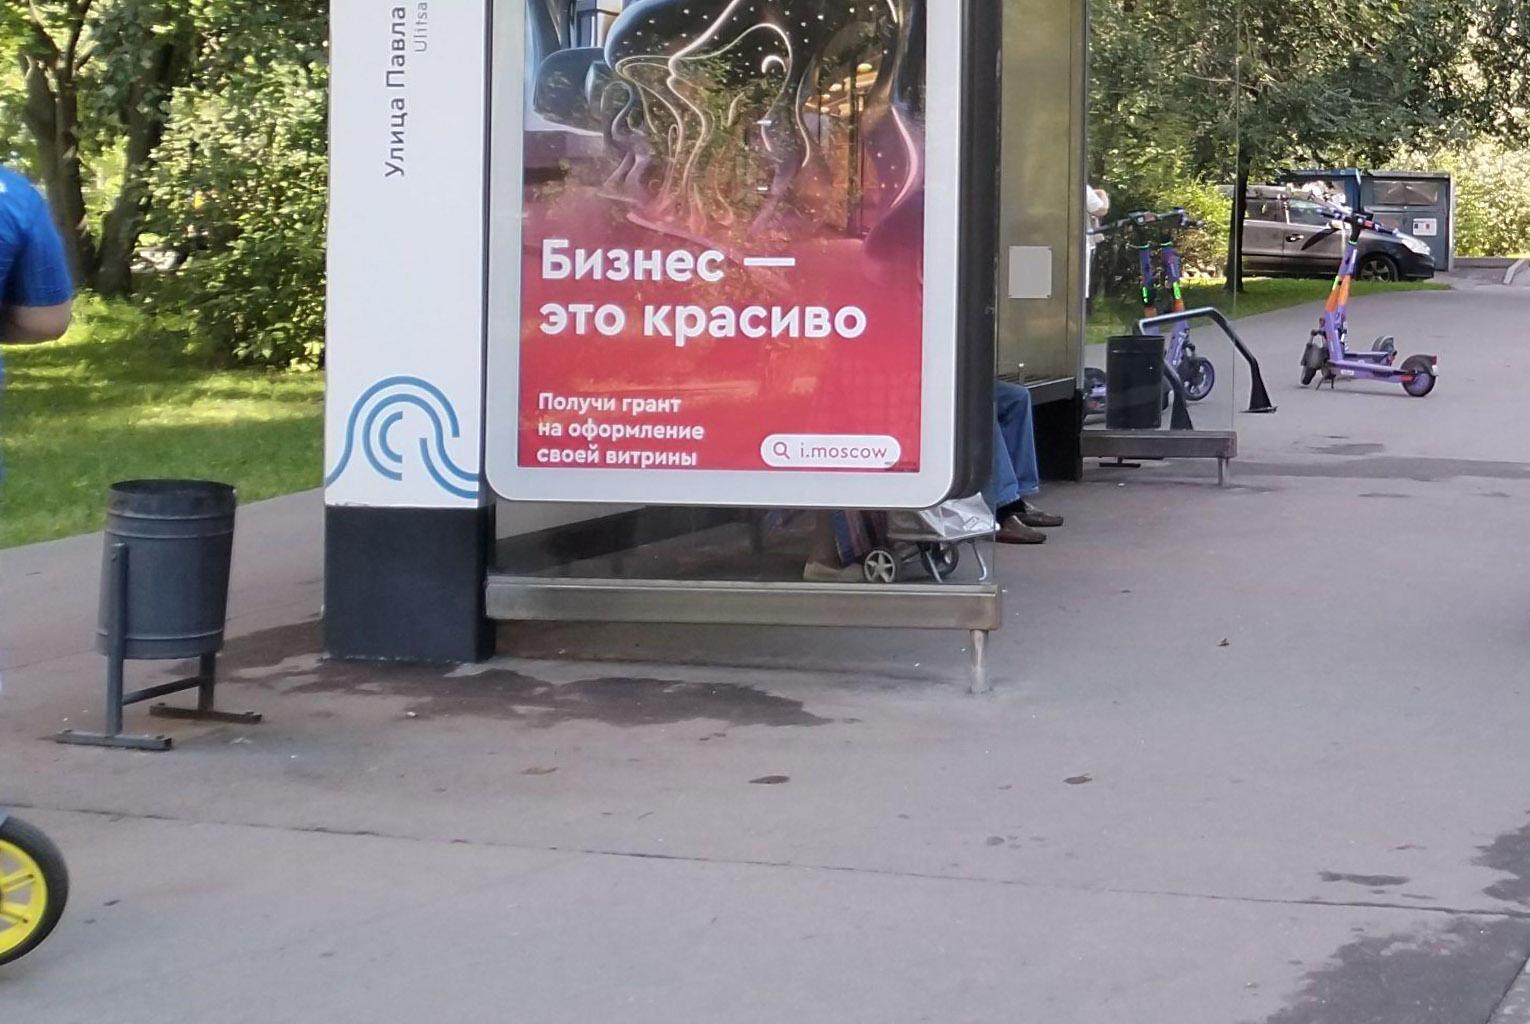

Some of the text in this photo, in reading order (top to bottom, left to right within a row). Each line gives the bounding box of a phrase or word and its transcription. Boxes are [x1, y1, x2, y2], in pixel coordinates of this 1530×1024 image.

[385, 6, 406, 88] Павла
[413, 2, 428, 53] Ulitsa
[384, 97, 408, 177] Улица
[542, 238, 725, 282] Бизнес
[539, 303, 867, 347] это красиво
[538, 392, 682, 416] Получи грант
[538, 418, 705, 442] на оформление
[800, 442, 888, 459] i.moscow
[536, 443, 697, 468] своей витрины
